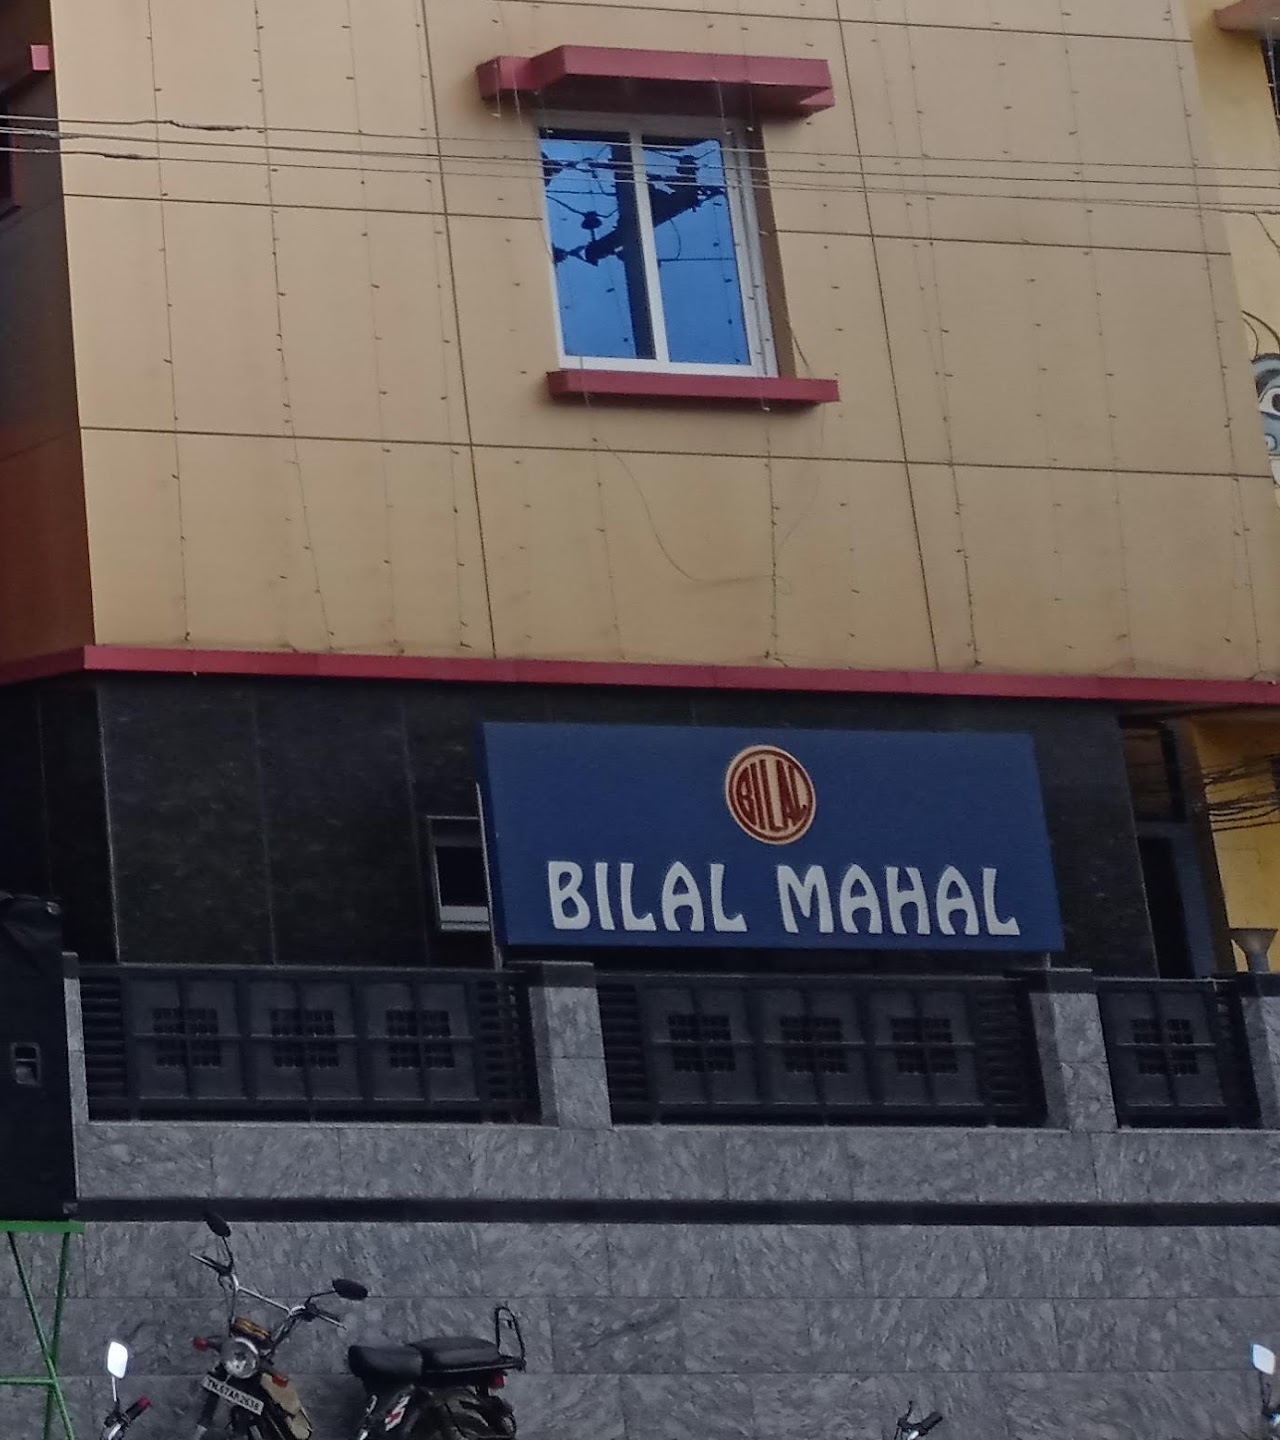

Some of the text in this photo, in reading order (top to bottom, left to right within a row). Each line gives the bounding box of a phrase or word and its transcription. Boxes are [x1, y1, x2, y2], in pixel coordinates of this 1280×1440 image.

[737, 759, 808, 831] BILAL
[547, 861, 1021, 936] BILAL MAHAL
